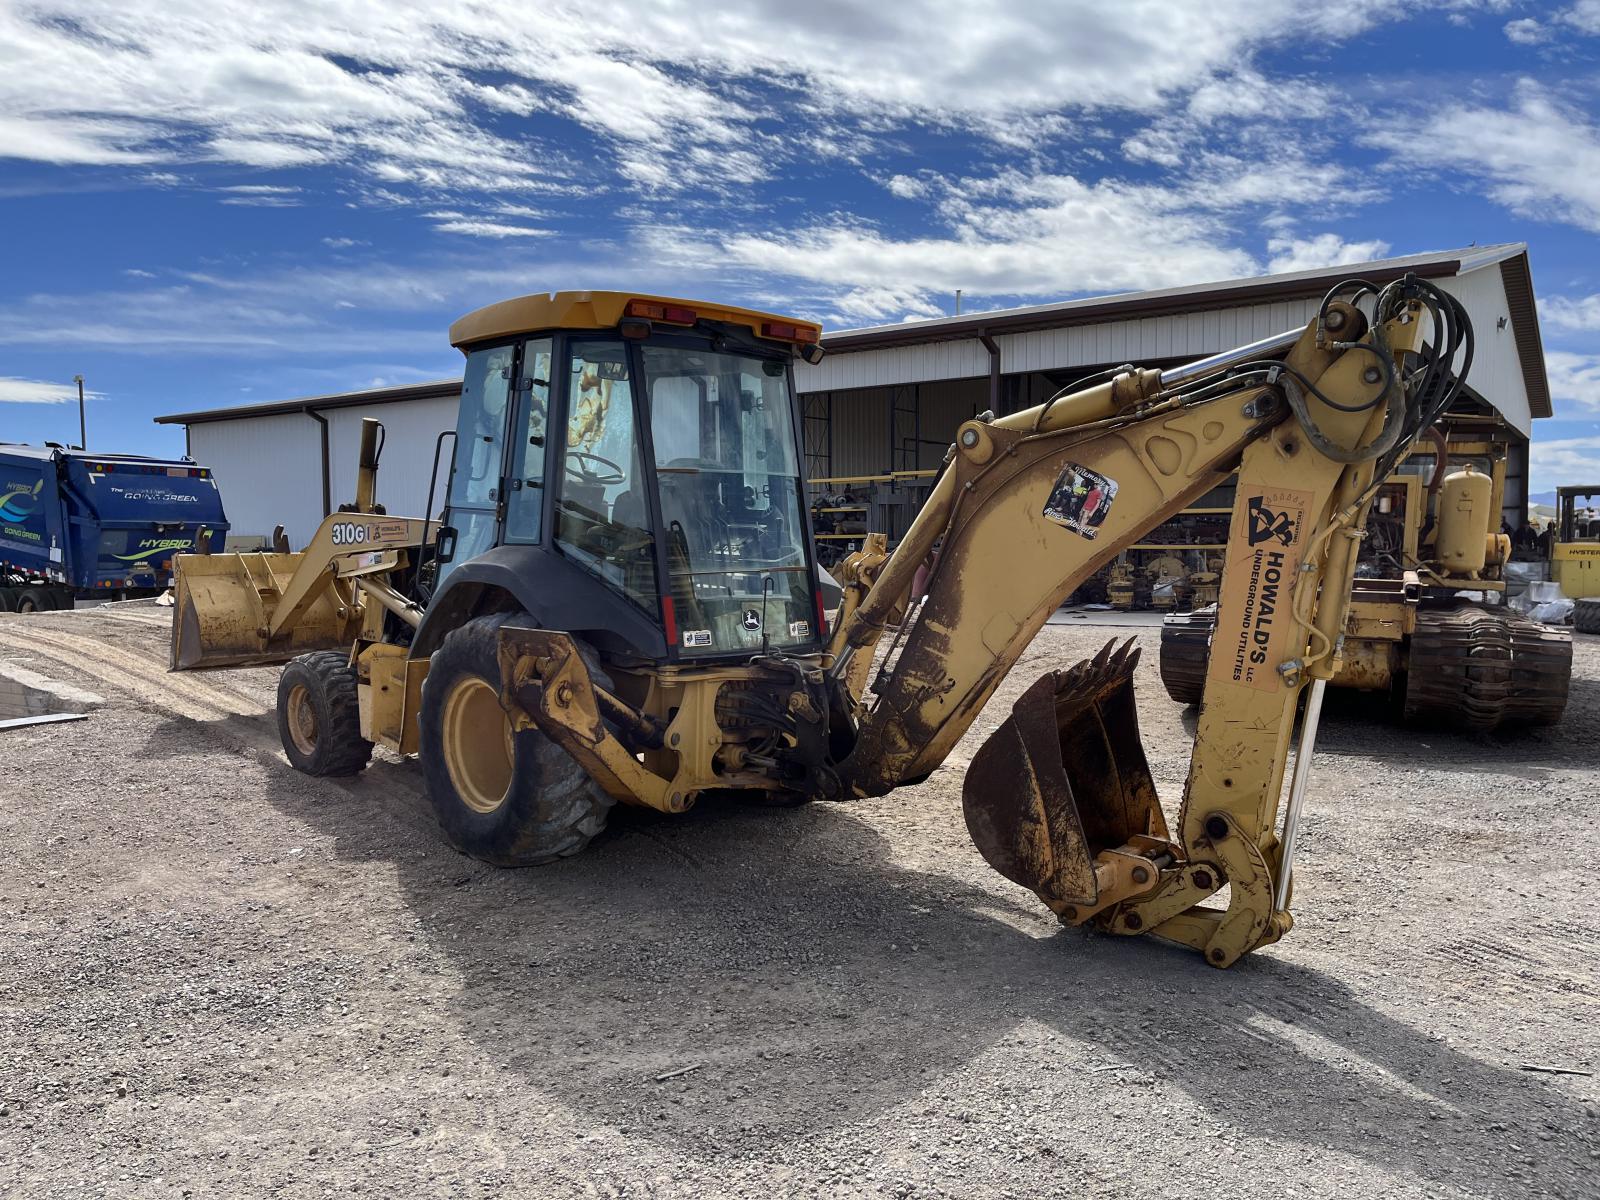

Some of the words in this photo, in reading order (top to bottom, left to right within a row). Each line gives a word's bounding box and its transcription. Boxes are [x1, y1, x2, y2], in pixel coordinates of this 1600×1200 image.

[4, 527, 22, 537] GOING
[22, 530, 41, 541] GREEN
[139, 539, 192, 548] HYBRID
[1241, 549, 1264, 629] UNDERGROUND
[1249, 551, 1285, 665] HOWALD'S
[1232, 631, 1249, 681] UTILITIES
[1246, 667, 1255, 683] LLC
